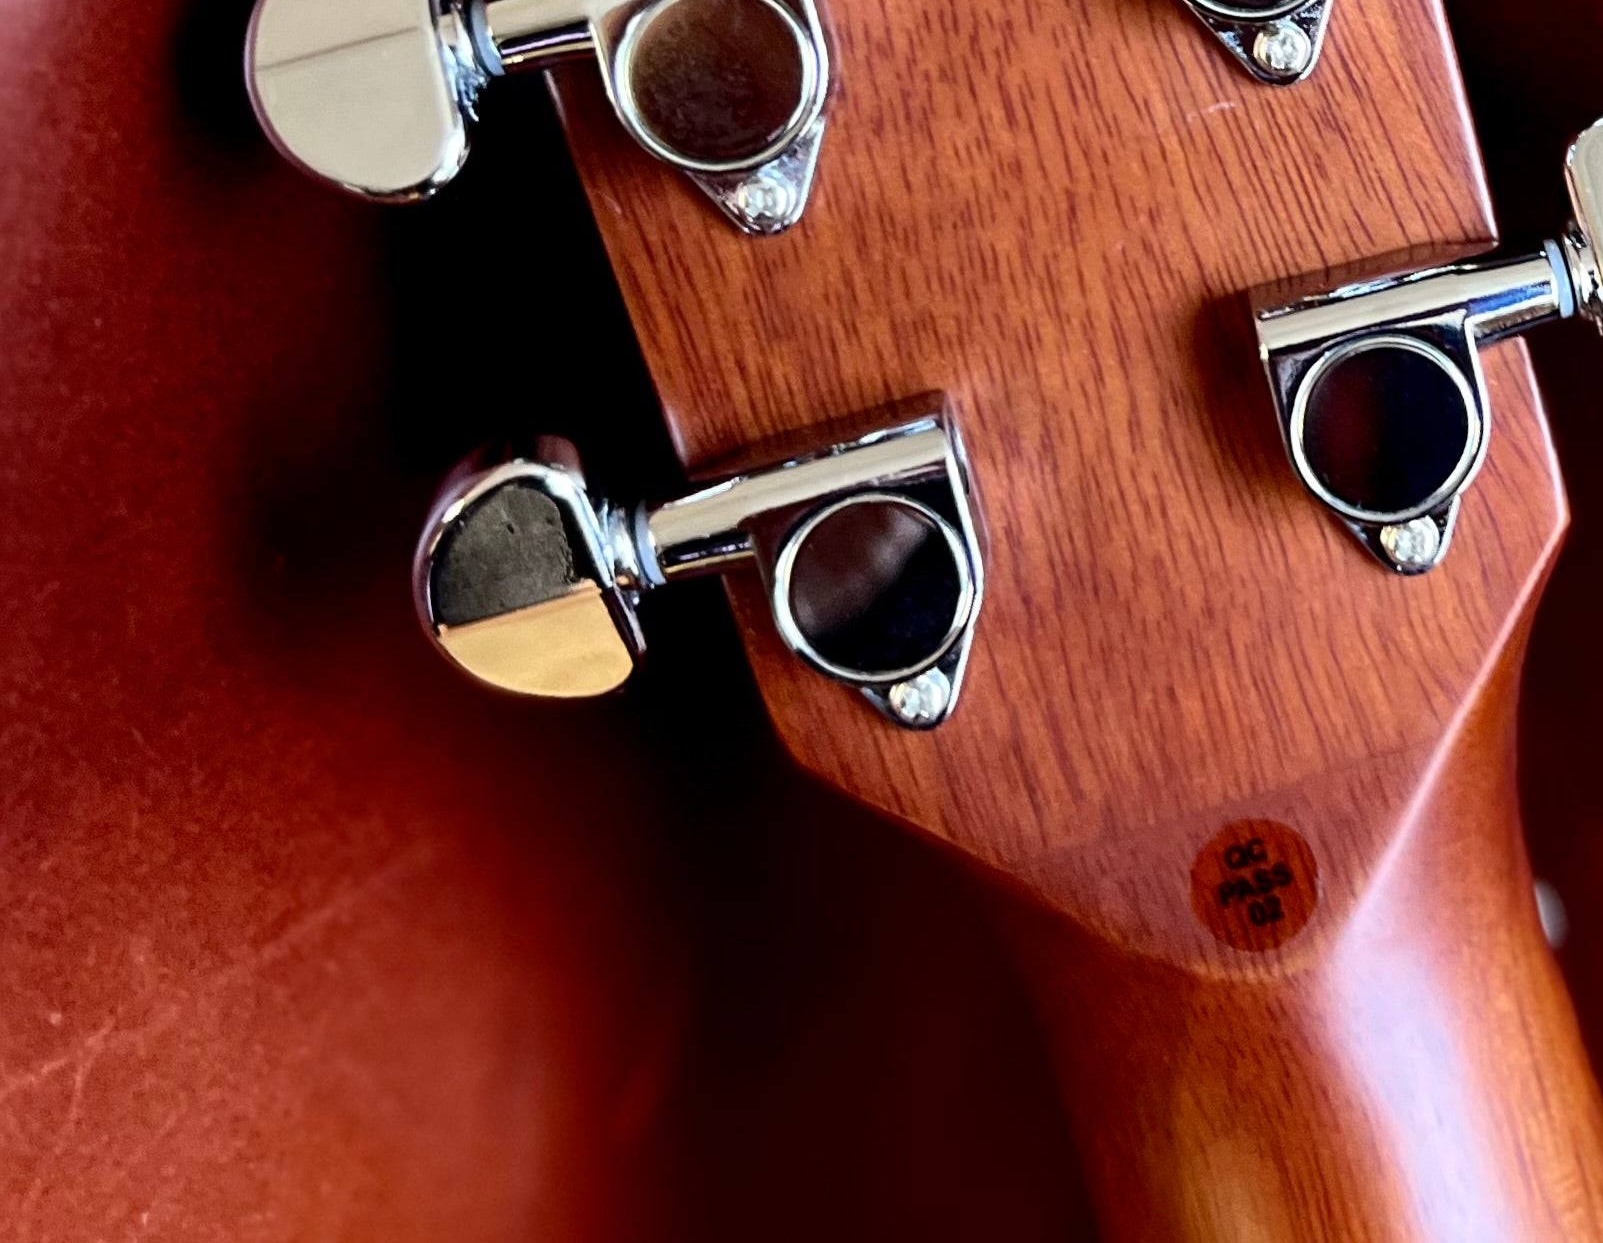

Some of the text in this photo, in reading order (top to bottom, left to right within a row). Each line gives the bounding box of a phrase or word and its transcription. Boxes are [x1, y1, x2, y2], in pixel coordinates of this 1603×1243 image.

[1225, 837, 1268, 869] QC
[1218, 862, 1293, 906] PASS
[1249, 895, 1285, 926] 02
